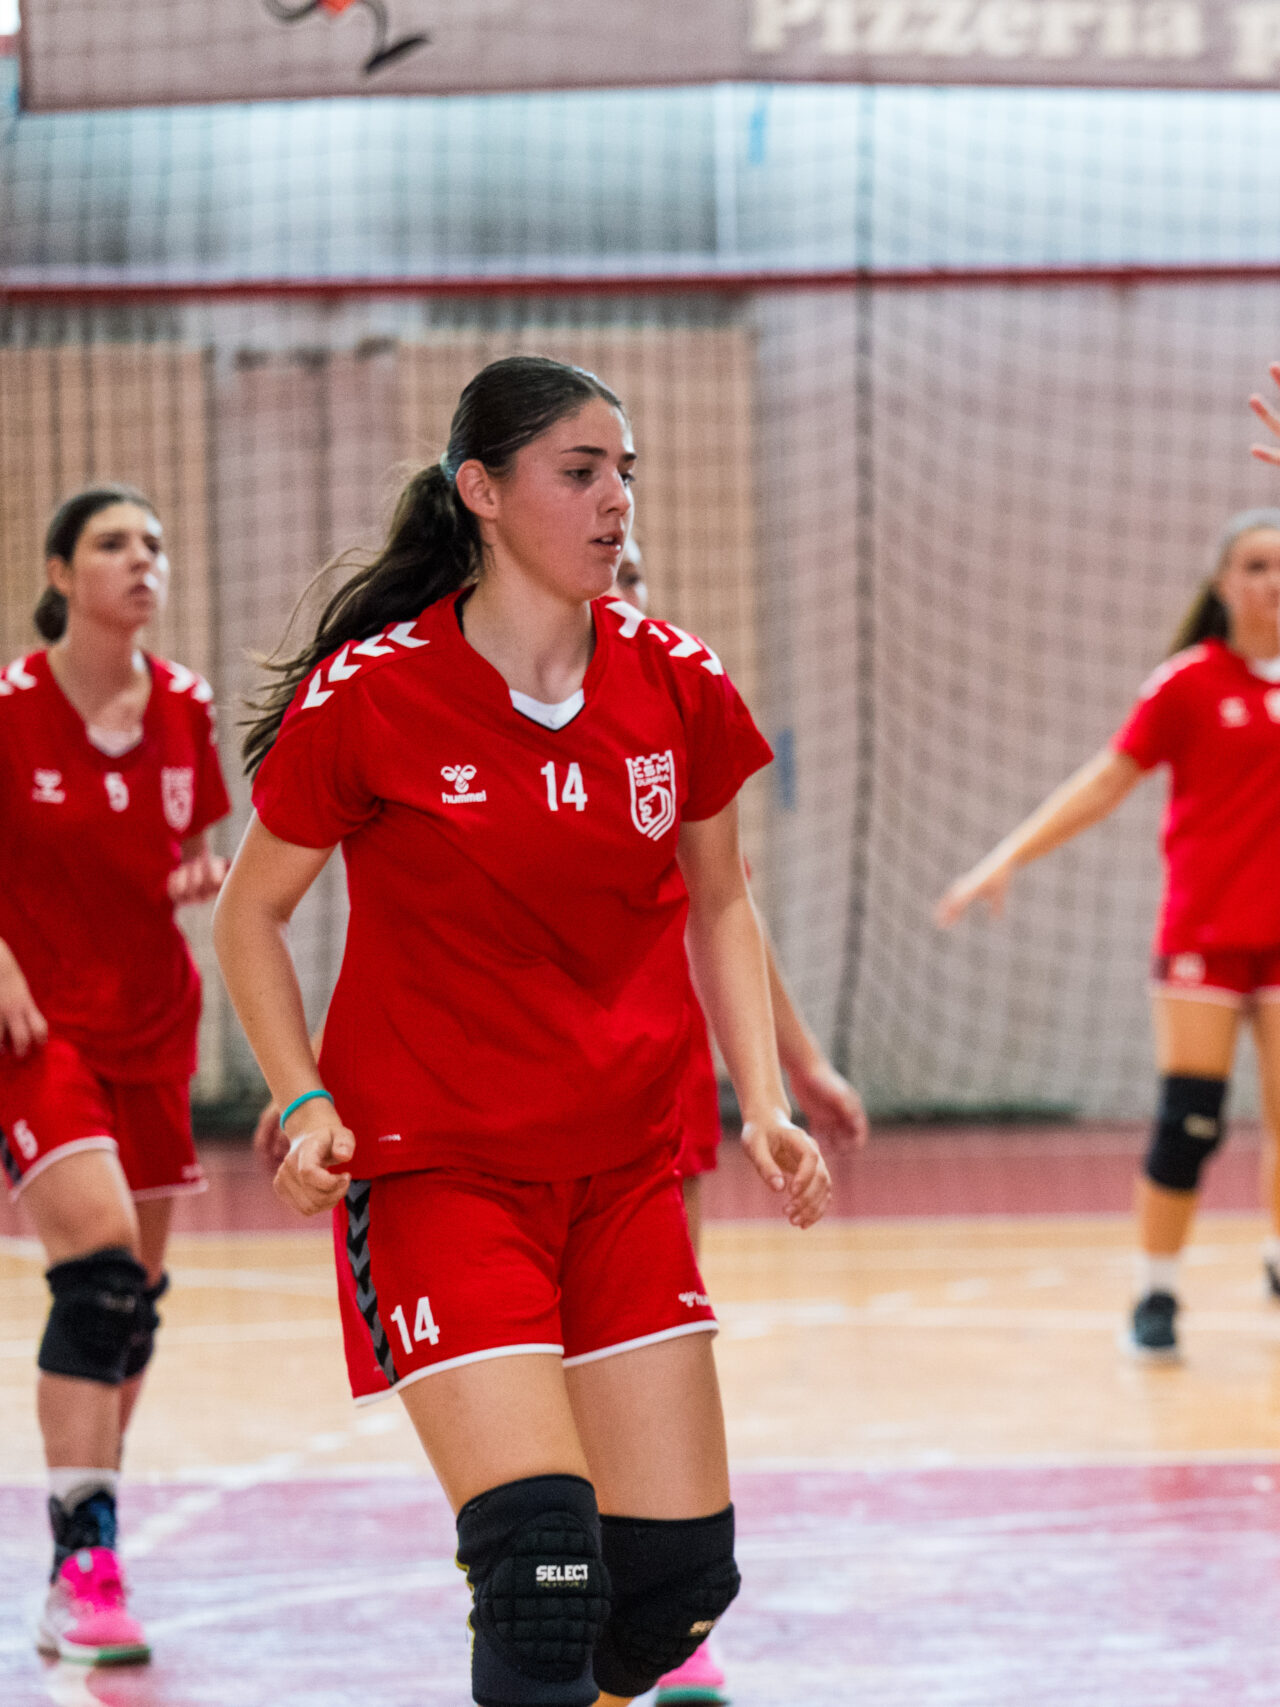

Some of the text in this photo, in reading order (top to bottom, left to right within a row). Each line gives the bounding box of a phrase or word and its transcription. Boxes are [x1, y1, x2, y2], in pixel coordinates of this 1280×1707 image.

[633, 762, 670, 779] CSM
[540, 761, 588, 812] 14
[441, 789, 487, 804] hummel
[390, 1296, 440, 1355] 14
[536, 1564, 588, 1582] SELECT
